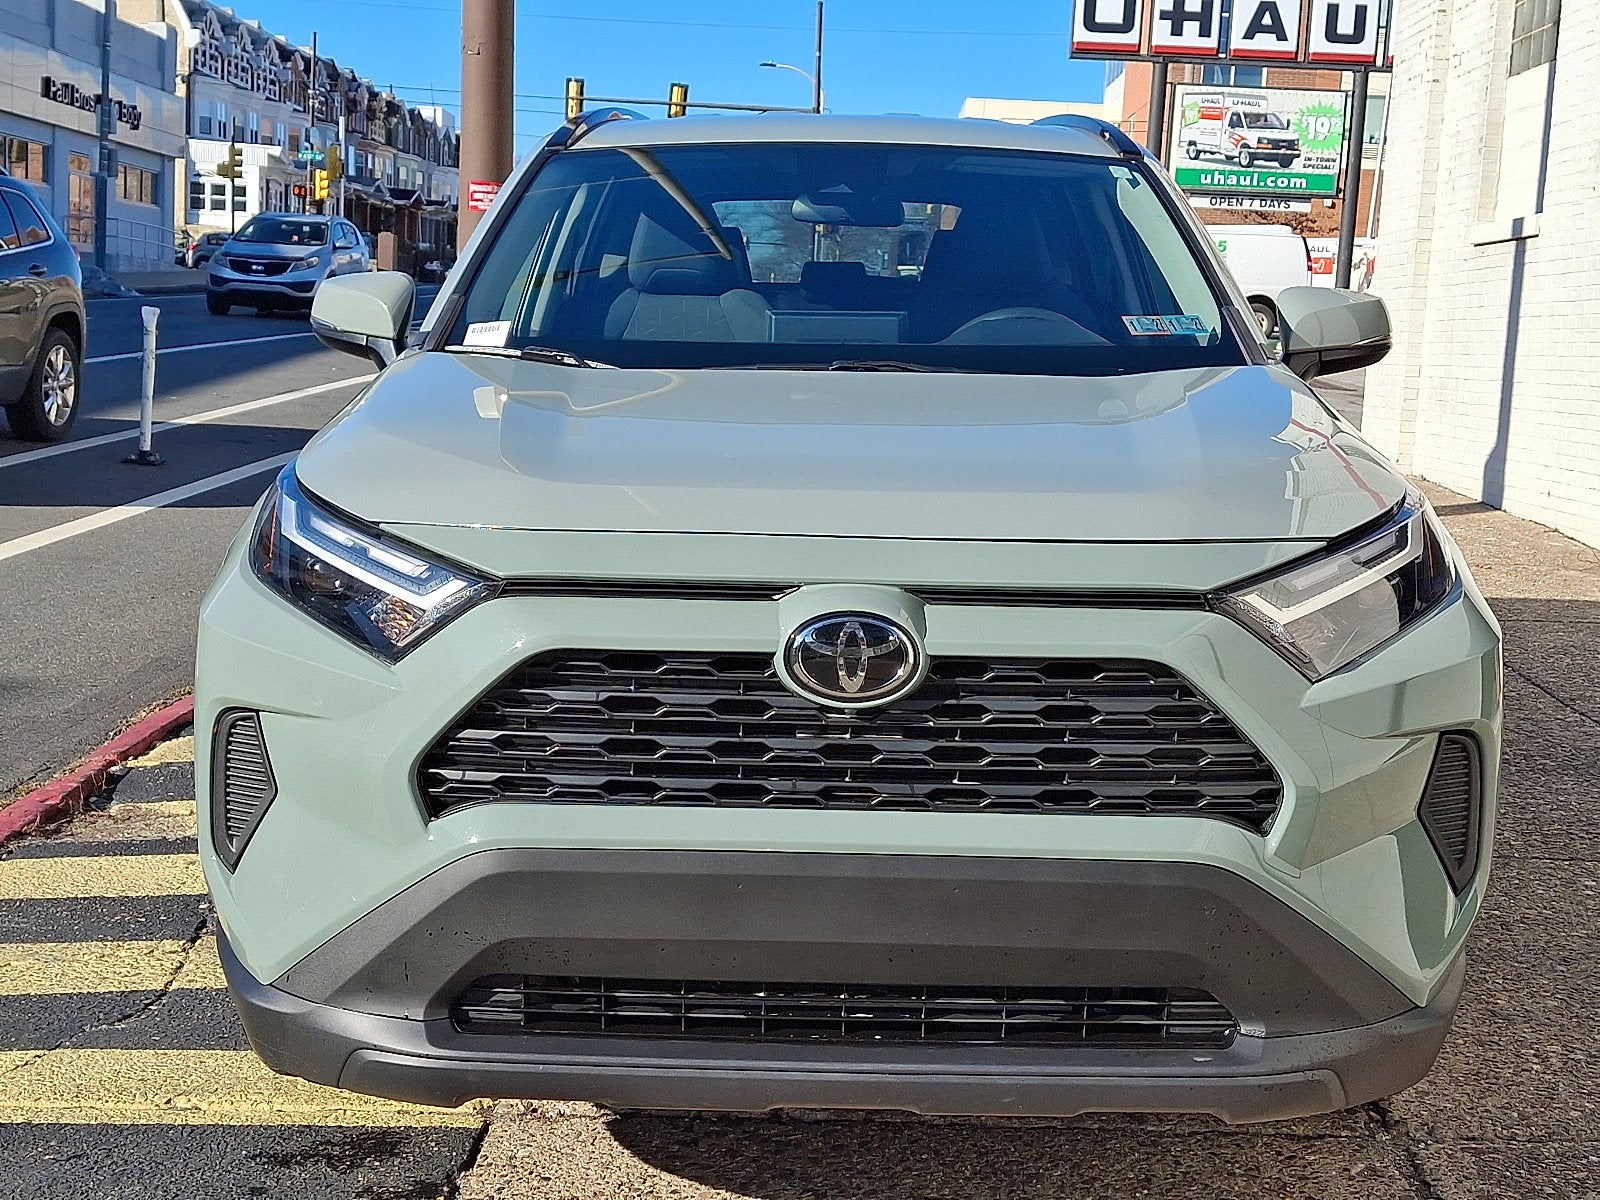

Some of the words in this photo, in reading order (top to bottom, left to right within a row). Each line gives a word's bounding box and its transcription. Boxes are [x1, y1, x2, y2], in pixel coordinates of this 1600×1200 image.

[50, 77, 72, 104] Paul
[73, 87, 95, 112] Bros
[1200, 170, 1307, 188] uhaul.com
[1209, 196, 1244, 207] OPEN
[1248, 198, 1255, 207] 7
[1259, 198, 1291, 209] DAYS
